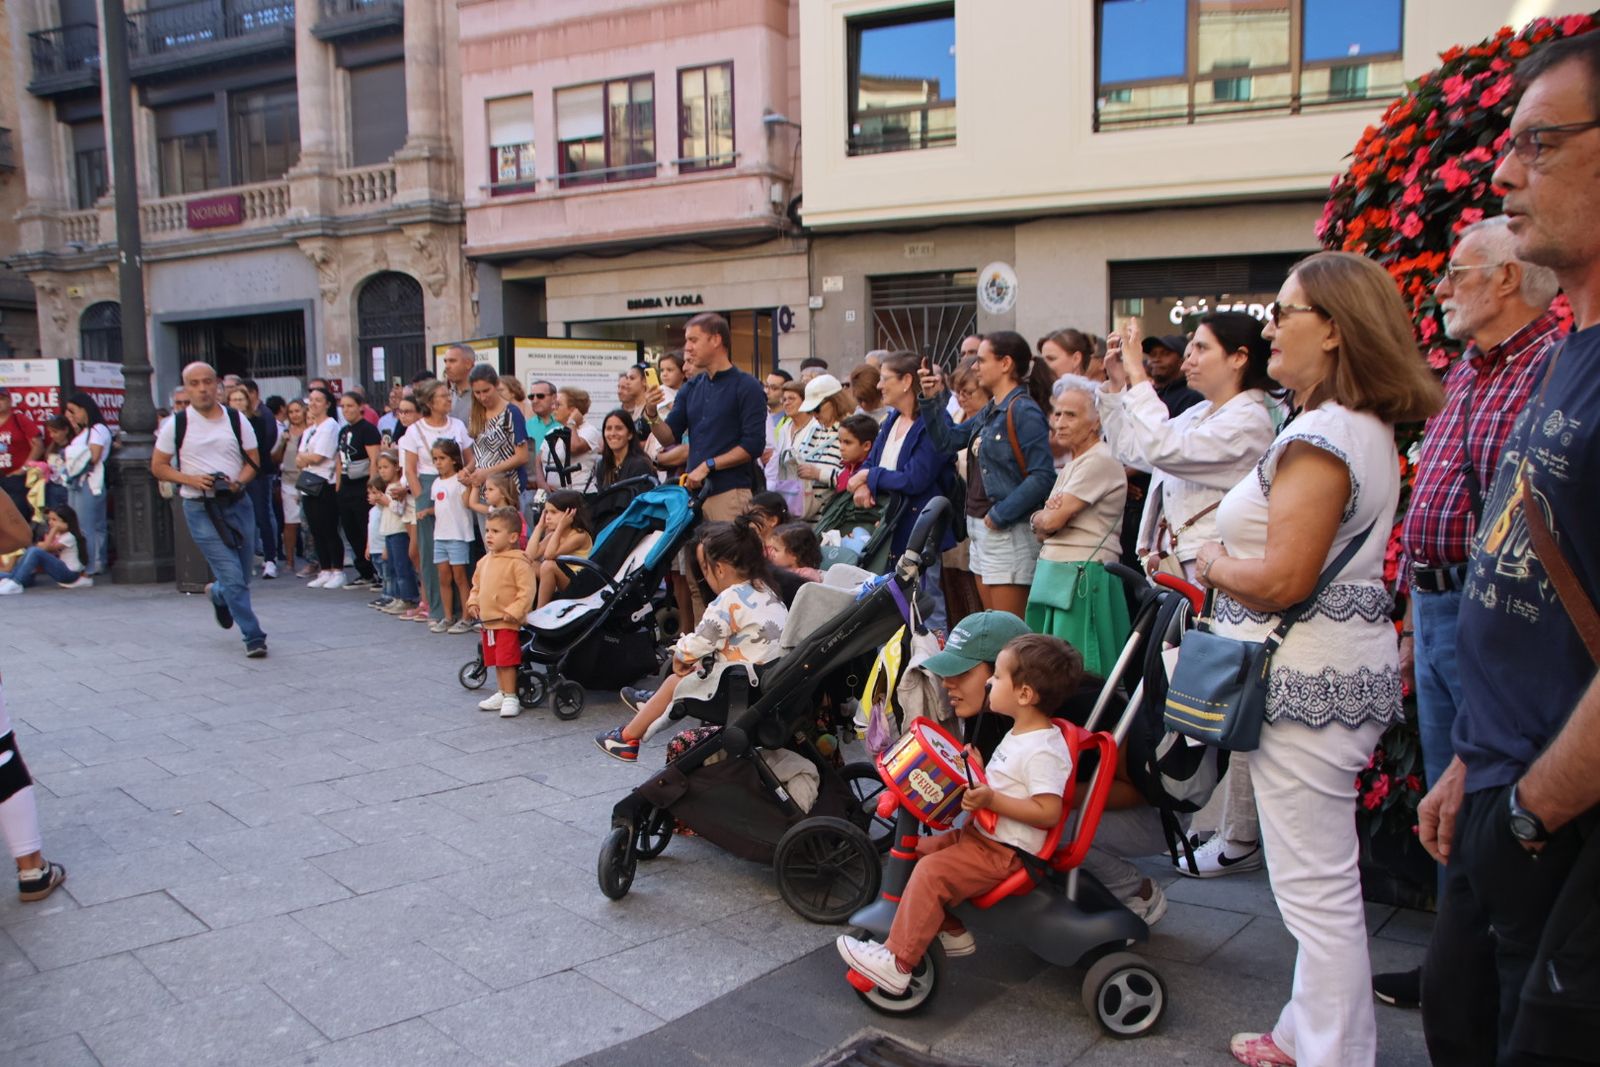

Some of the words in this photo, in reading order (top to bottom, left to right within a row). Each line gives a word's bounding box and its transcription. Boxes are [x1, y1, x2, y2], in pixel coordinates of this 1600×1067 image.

[627, 297, 663, 310] BIMBA
[664, 296, 674, 307] Y
[675, 294, 704, 307] LOLA
[25, 387, 60, 408] OLÉ
